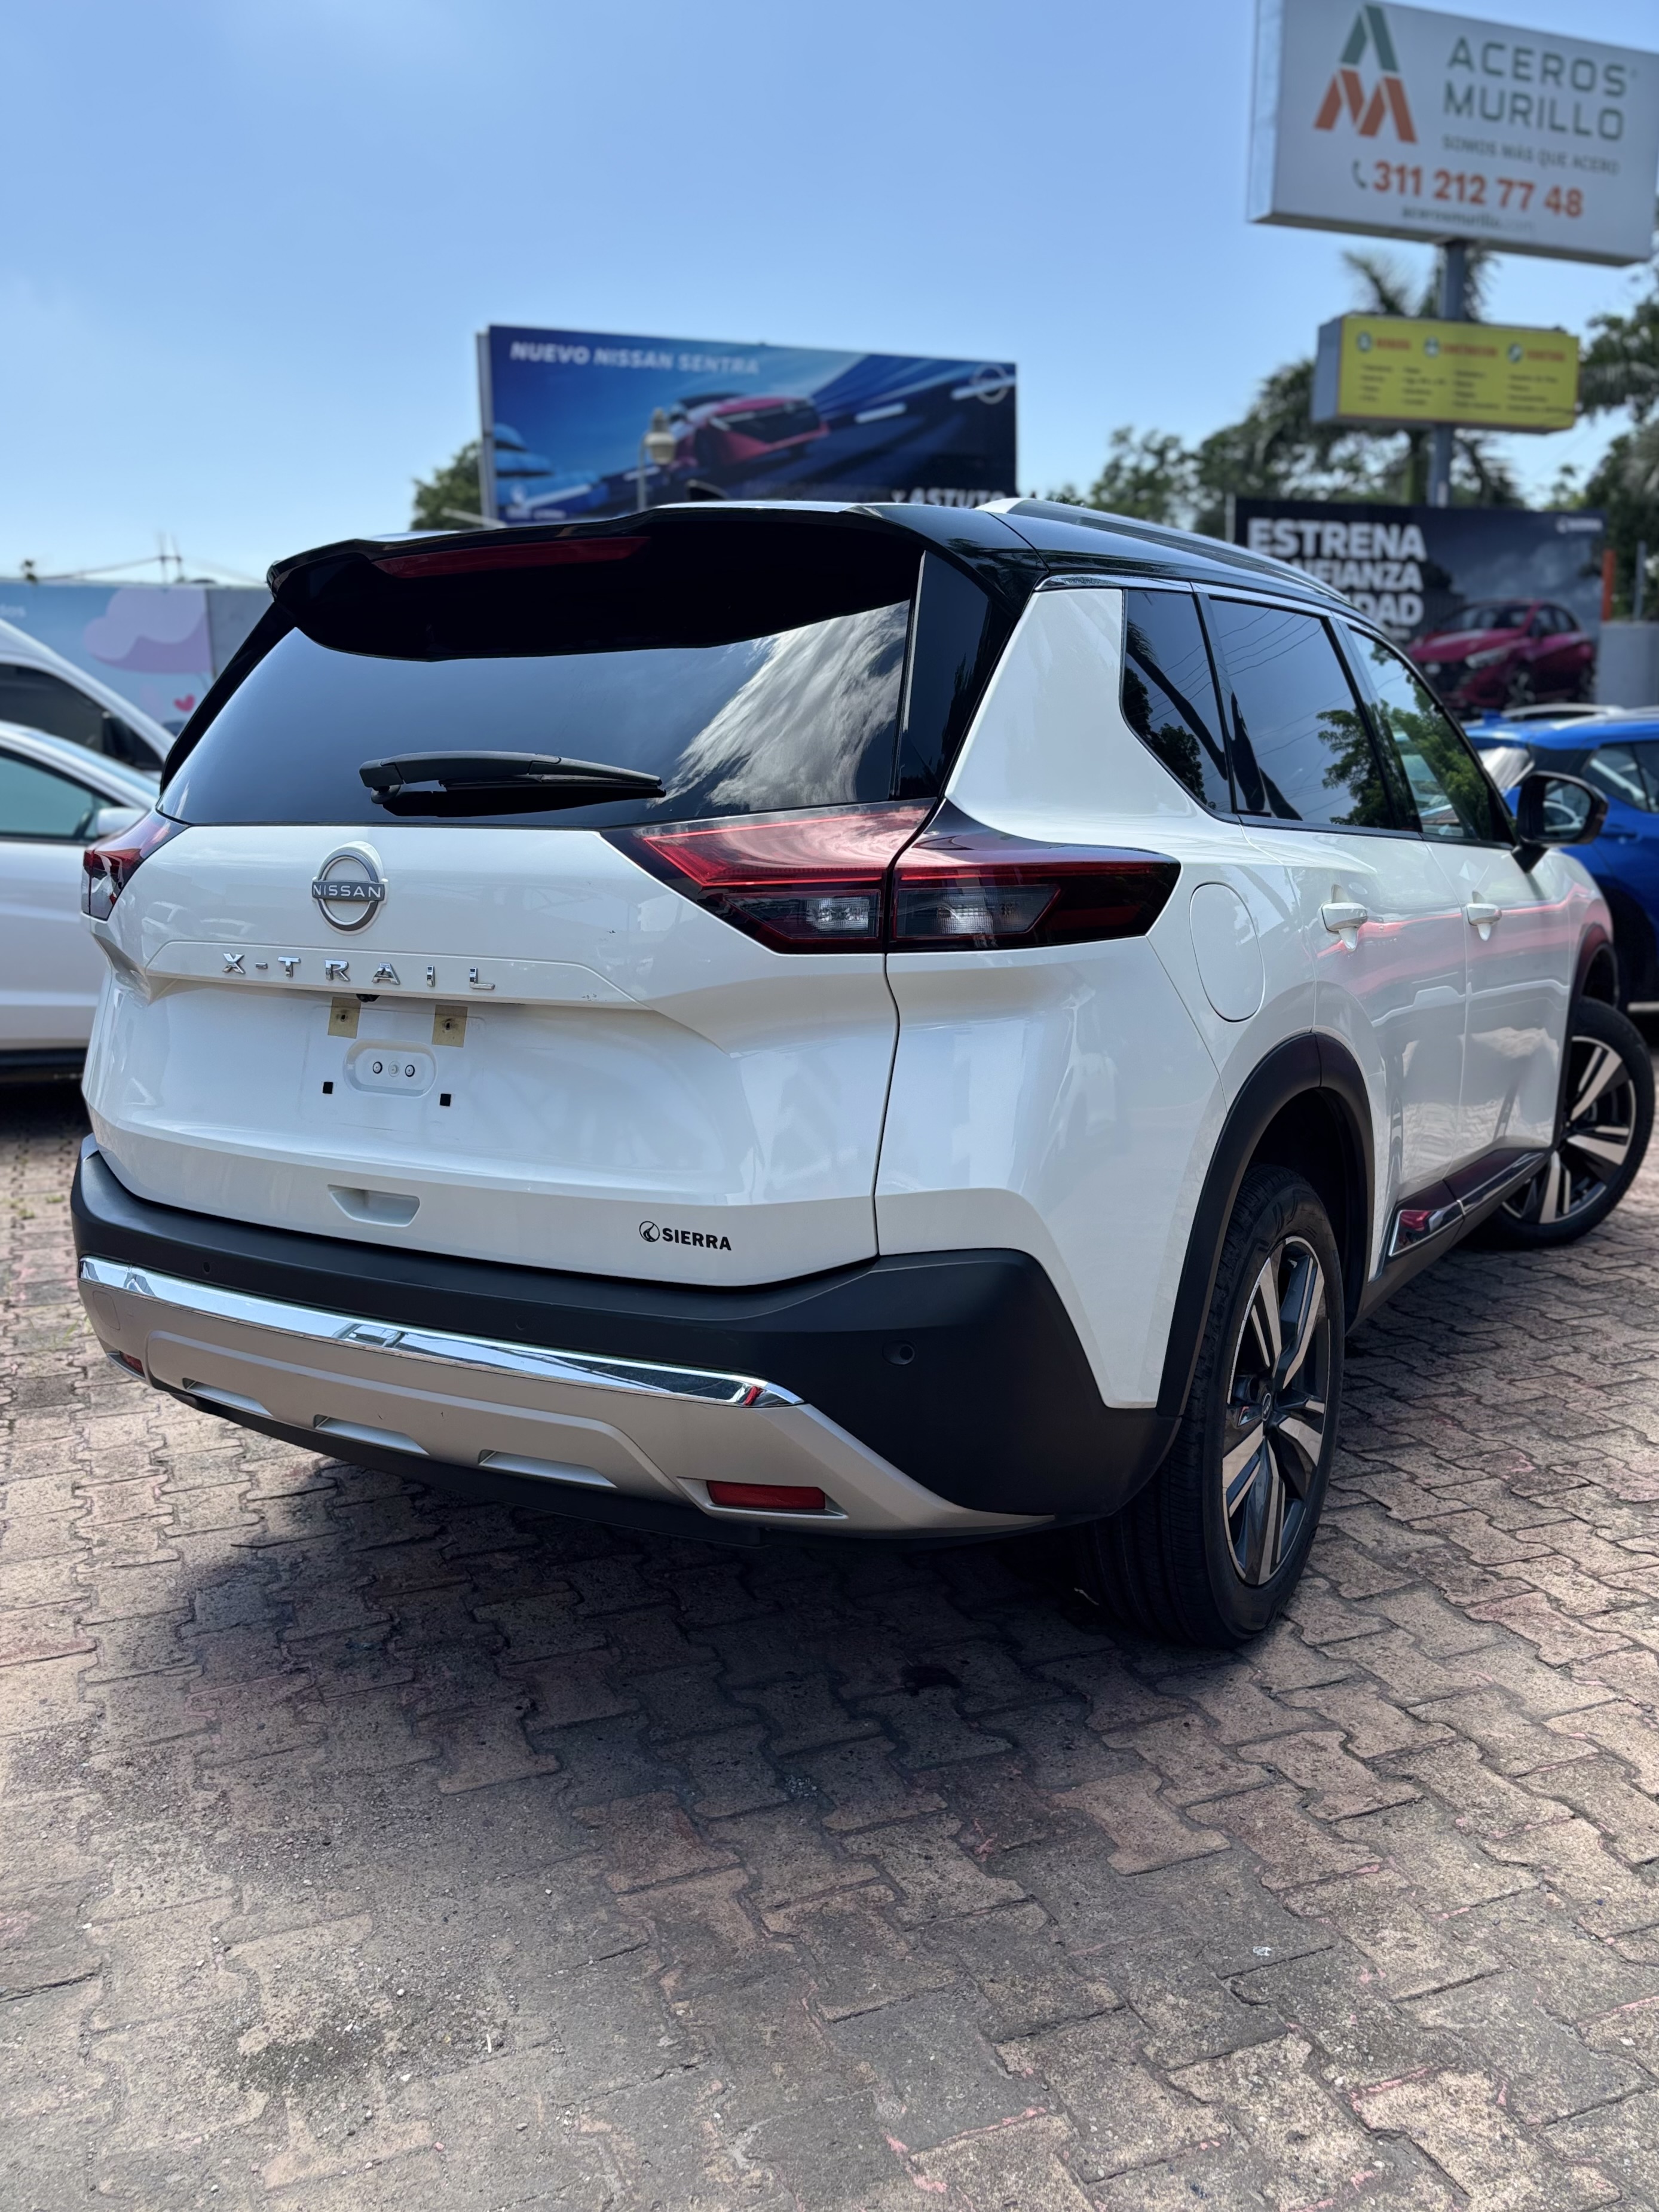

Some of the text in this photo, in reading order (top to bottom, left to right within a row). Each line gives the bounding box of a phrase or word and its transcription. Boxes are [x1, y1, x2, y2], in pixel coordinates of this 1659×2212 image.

[1447, 35, 1627, 99] ACEROS
[1443, 79, 1625, 142] MURILLO
[1373, 160, 1584, 219] 311 212 77 48
[509, 341, 760, 376] NUEVO NISSAN SENTRA
[1248, 517, 1428, 562] ESTRENA
[313, 884, 381, 899] NISSAN
[222, 952, 496, 990] X-TRAIL
[662, 1227, 732, 1251] SIERRA
